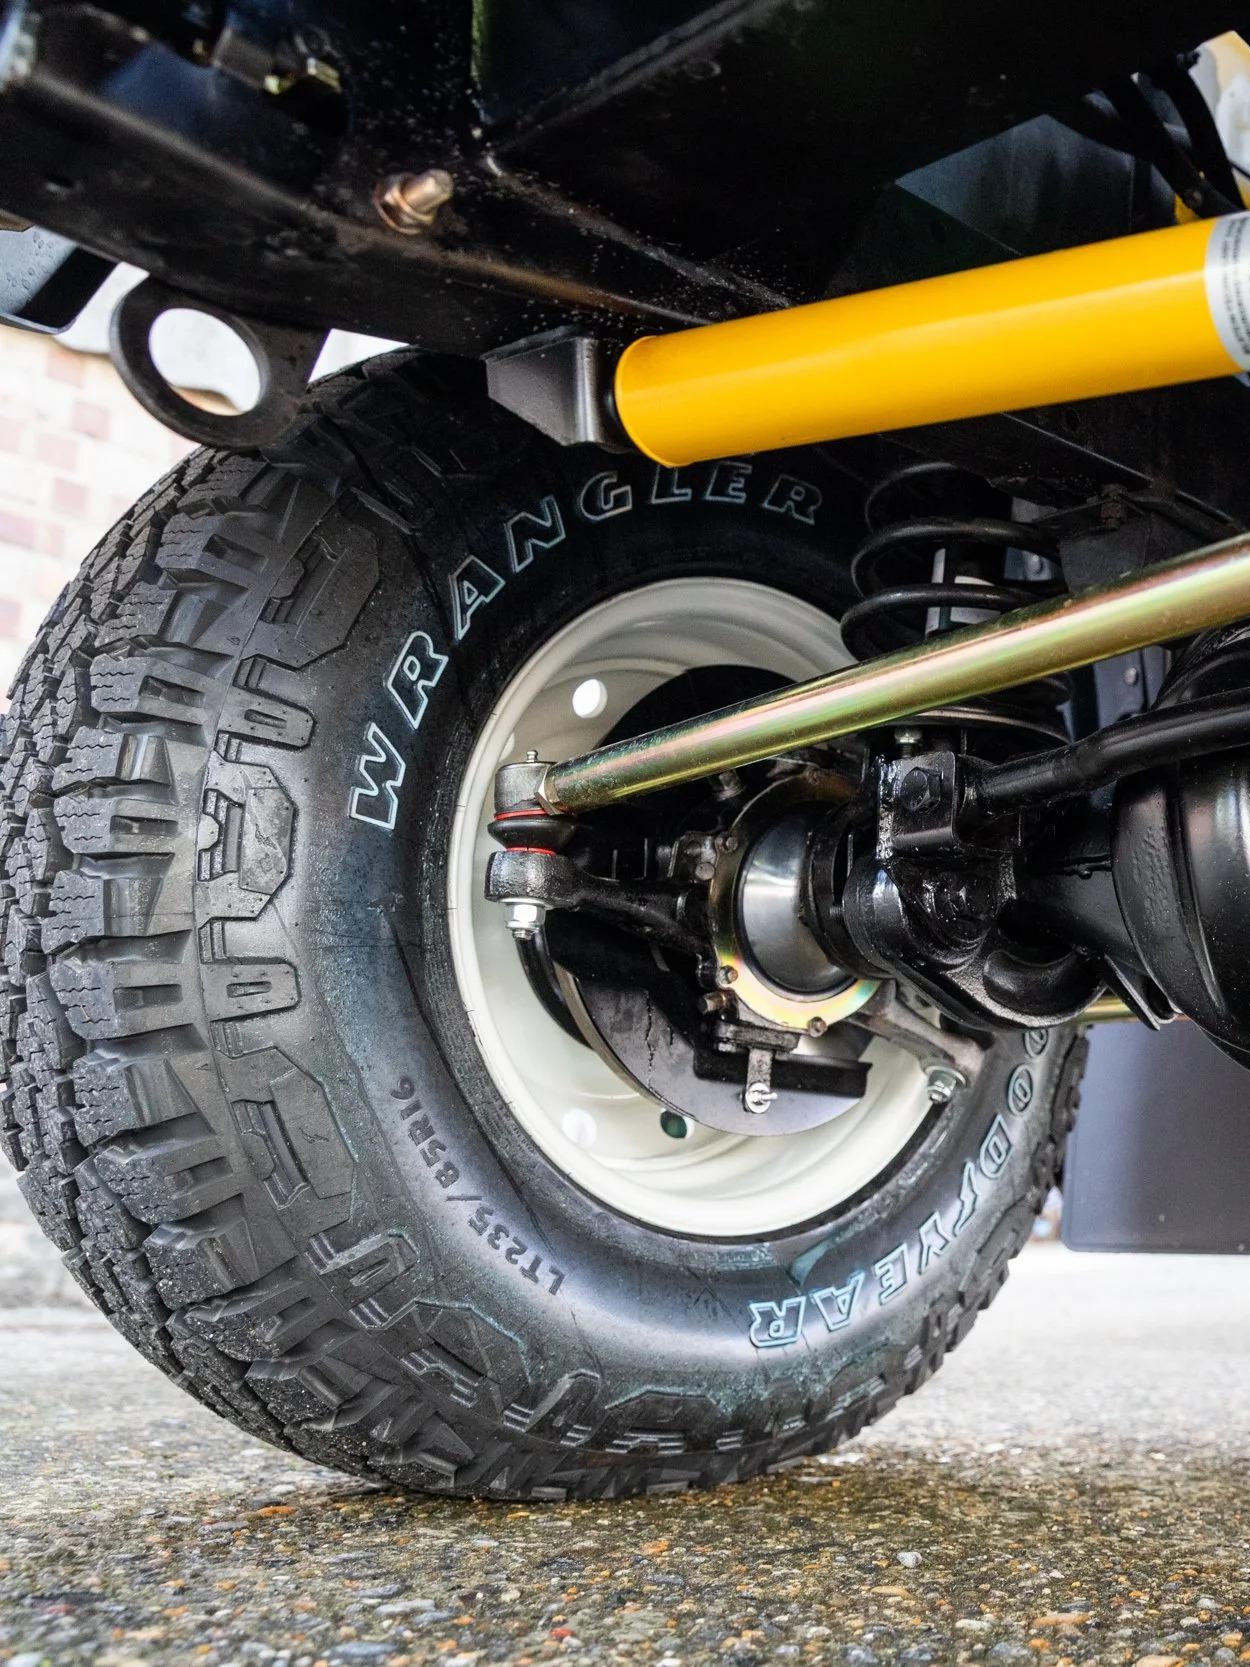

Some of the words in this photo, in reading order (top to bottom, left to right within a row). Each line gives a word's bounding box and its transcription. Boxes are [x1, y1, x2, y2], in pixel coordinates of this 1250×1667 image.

[349, 460, 823, 830] WRANGLER
[389, 1076, 567, 1296] LT235/85R16
[749, 1028, 1051, 1348] OODYEAR
